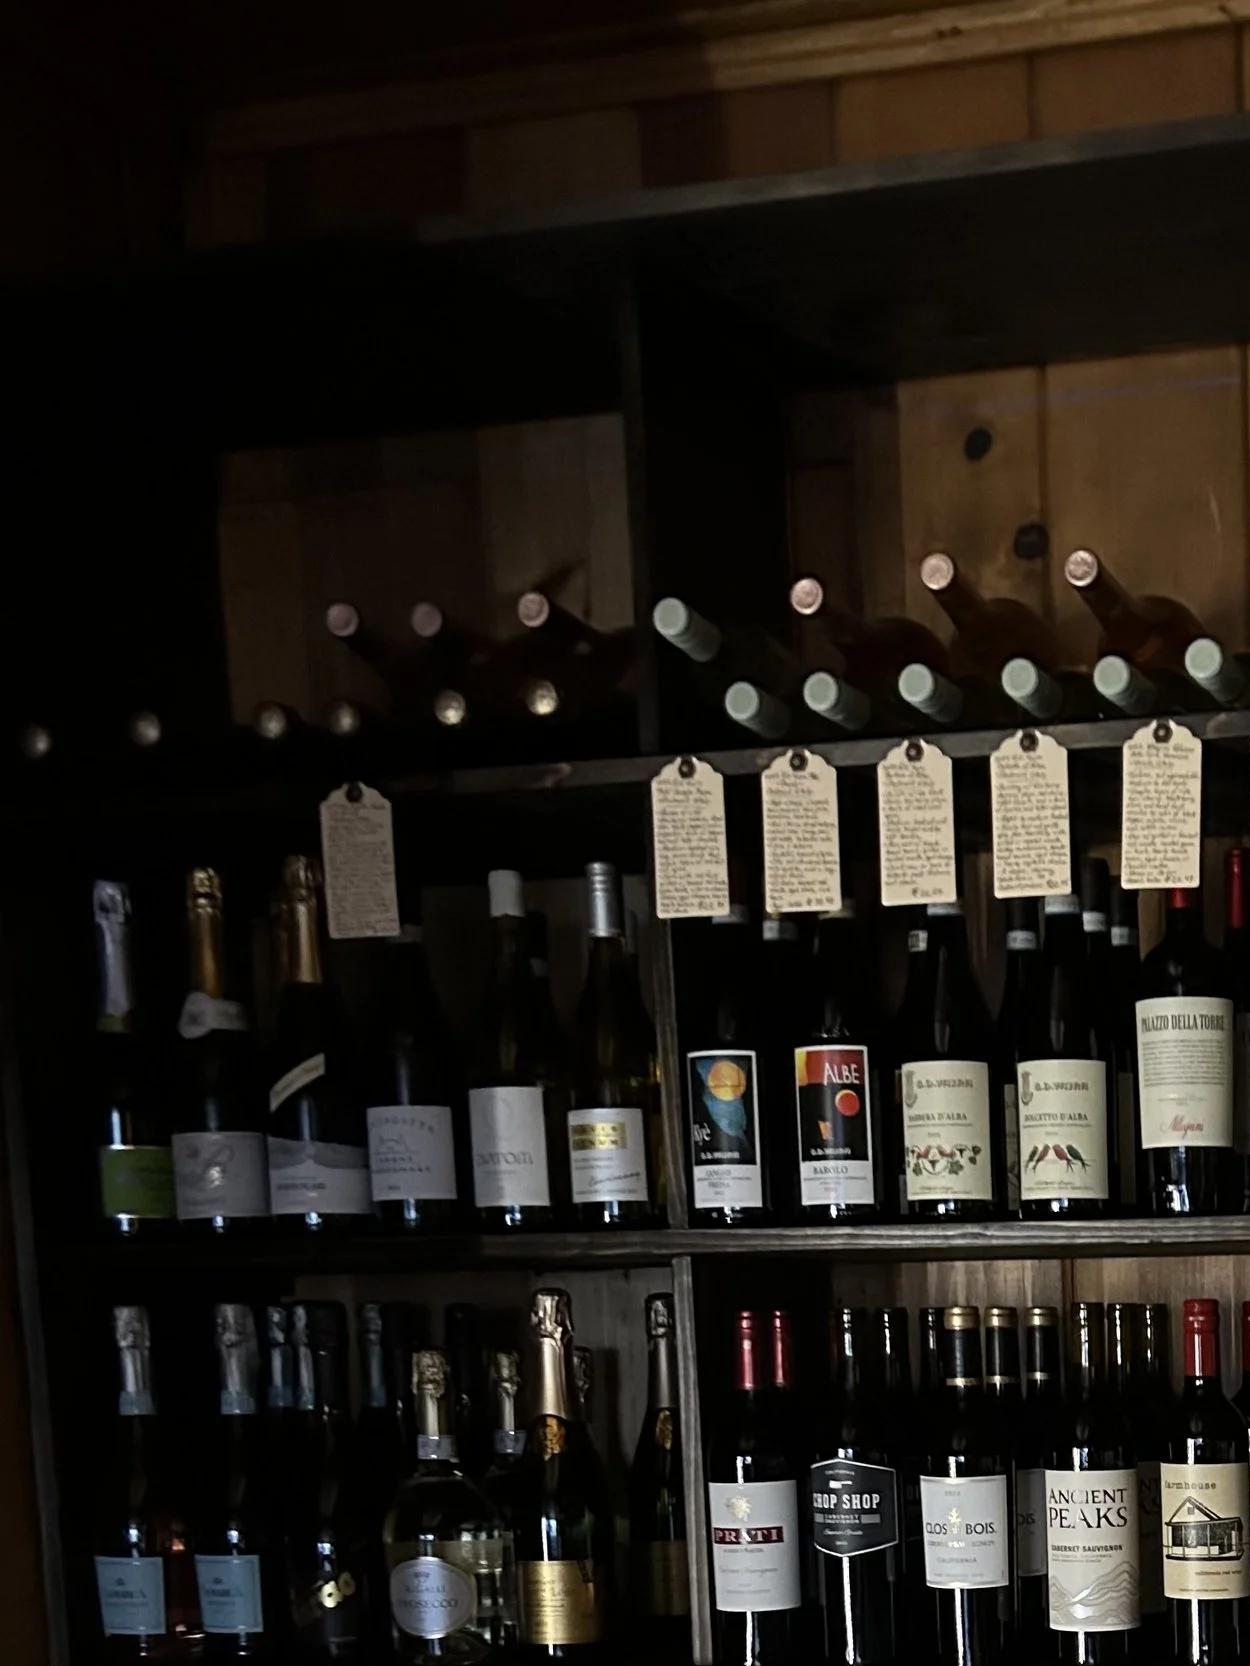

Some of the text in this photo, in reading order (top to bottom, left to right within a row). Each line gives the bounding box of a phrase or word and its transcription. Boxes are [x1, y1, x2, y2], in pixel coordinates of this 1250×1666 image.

[1141, 1016, 1170, 1032] PALAZZO
[1171, 1016, 1198, 1031] DELLA
[824, 1063, 860, 1084] ALBE
[813, 1165, 849, 1176] BAROLO
[842, 1493, 880, 1510] SHOP
[1049, 1488, 1128, 1504] ANCIENT
[1049, 1507, 1128, 1528] PEAKS
[926, 1522, 994, 1535] CLOS BOIS
[1052, 1544, 1123, 1552] CABERNET SAUVIGNON
